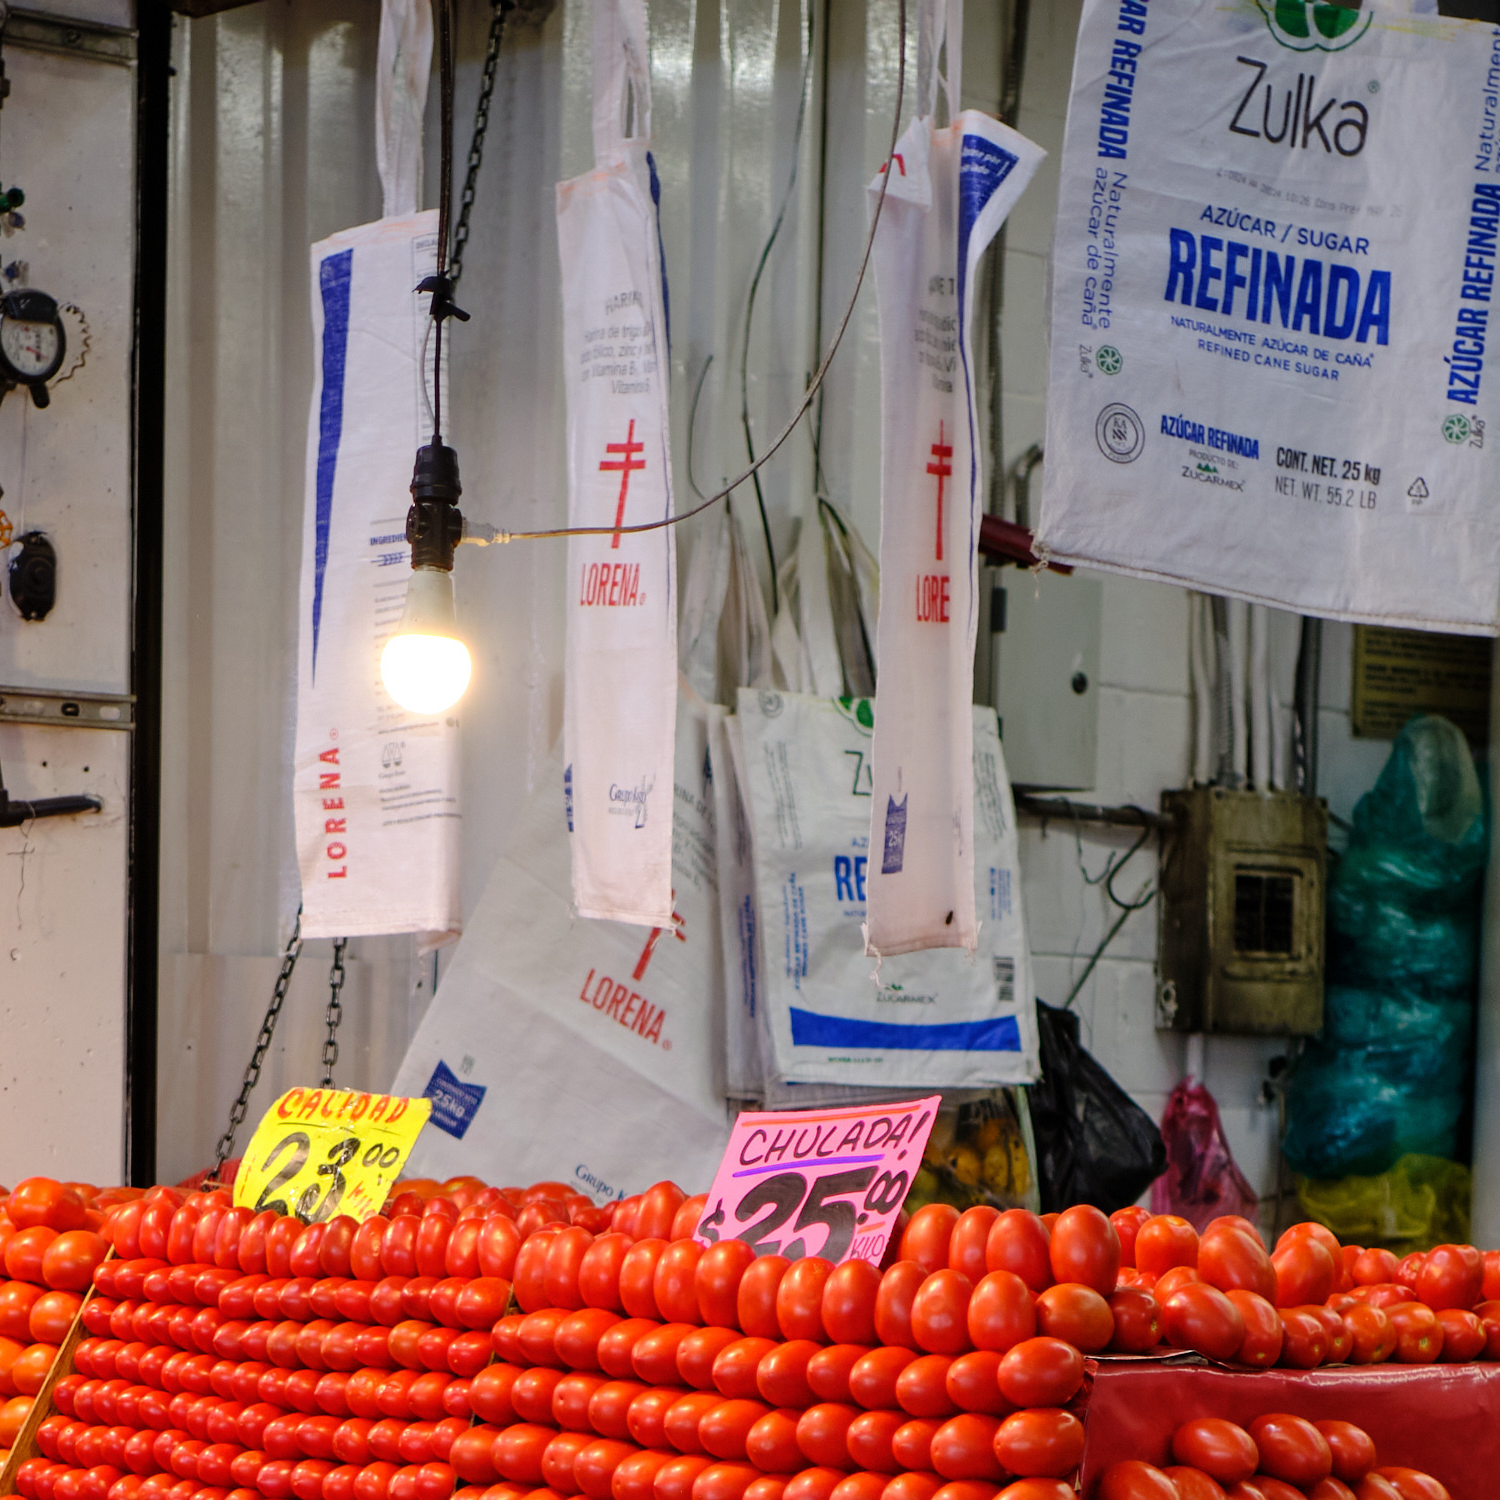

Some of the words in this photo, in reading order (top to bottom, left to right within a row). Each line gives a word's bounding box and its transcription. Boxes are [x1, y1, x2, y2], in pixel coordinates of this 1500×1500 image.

[1097, 38, 1144, 160] REFINADA
[1228, 55, 1369, 157] Zulka
[1086, 167, 1110, 240] azúcar
[1199, 203, 1277, 239] AZÚCAR
[1296, 227, 1371, 255] SUGAR
[1086, 245, 1101, 272] de
[1098, 170, 1129, 330] Naturalmente
[1080, 276, 1100, 331] caña
[1164, 226, 1392, 346] REFINADA
[1170, 314, 1257, 346] NATURALMENTE
[1261, 336, 1310, 358] AZÚCAR
[1313, 346, 1330, 362] DE
[1335, 350, 1373, 369] CAÑA
[1198, 337, 1251, 363] REFINED
[1254, 351, 1292, 371] CANE
[1295, 361, 1340, 382] SUGAR
[1444, 305, 1490, 406] AZÚCAR
[1160, 413, 1207, 446] AZÚCAR
[1206, 426, 1260, 461] REFINADA
[1189, 448, 1226, 467] PRODUCTO
[1181, 465, 1244, 493] ZUCARMEX
[1276, 446, 1309, 473] CONT.
[1311, 454, 1339, 480] NET.
[1341, 460, 1362, 482] 25
[1363, 462, 1382, 486] kg
[1274, 475, 1299, 499] NET.
[1301, 481, 1323, 503] WT.
[1325, 485, 1356, 508] 55.2
[1359, 489, 1378, 511] LB
[580, 562, 641, 607] LORENA
[318, 746, 348, 880] LORENA
[578, 967, 668, 1047] LORENA
[276, 1086, 411, 1124] CALIDAD
[738, 1109, 932, 1167] CHULADA!
[850, 1233, 886, 1261] KILO
